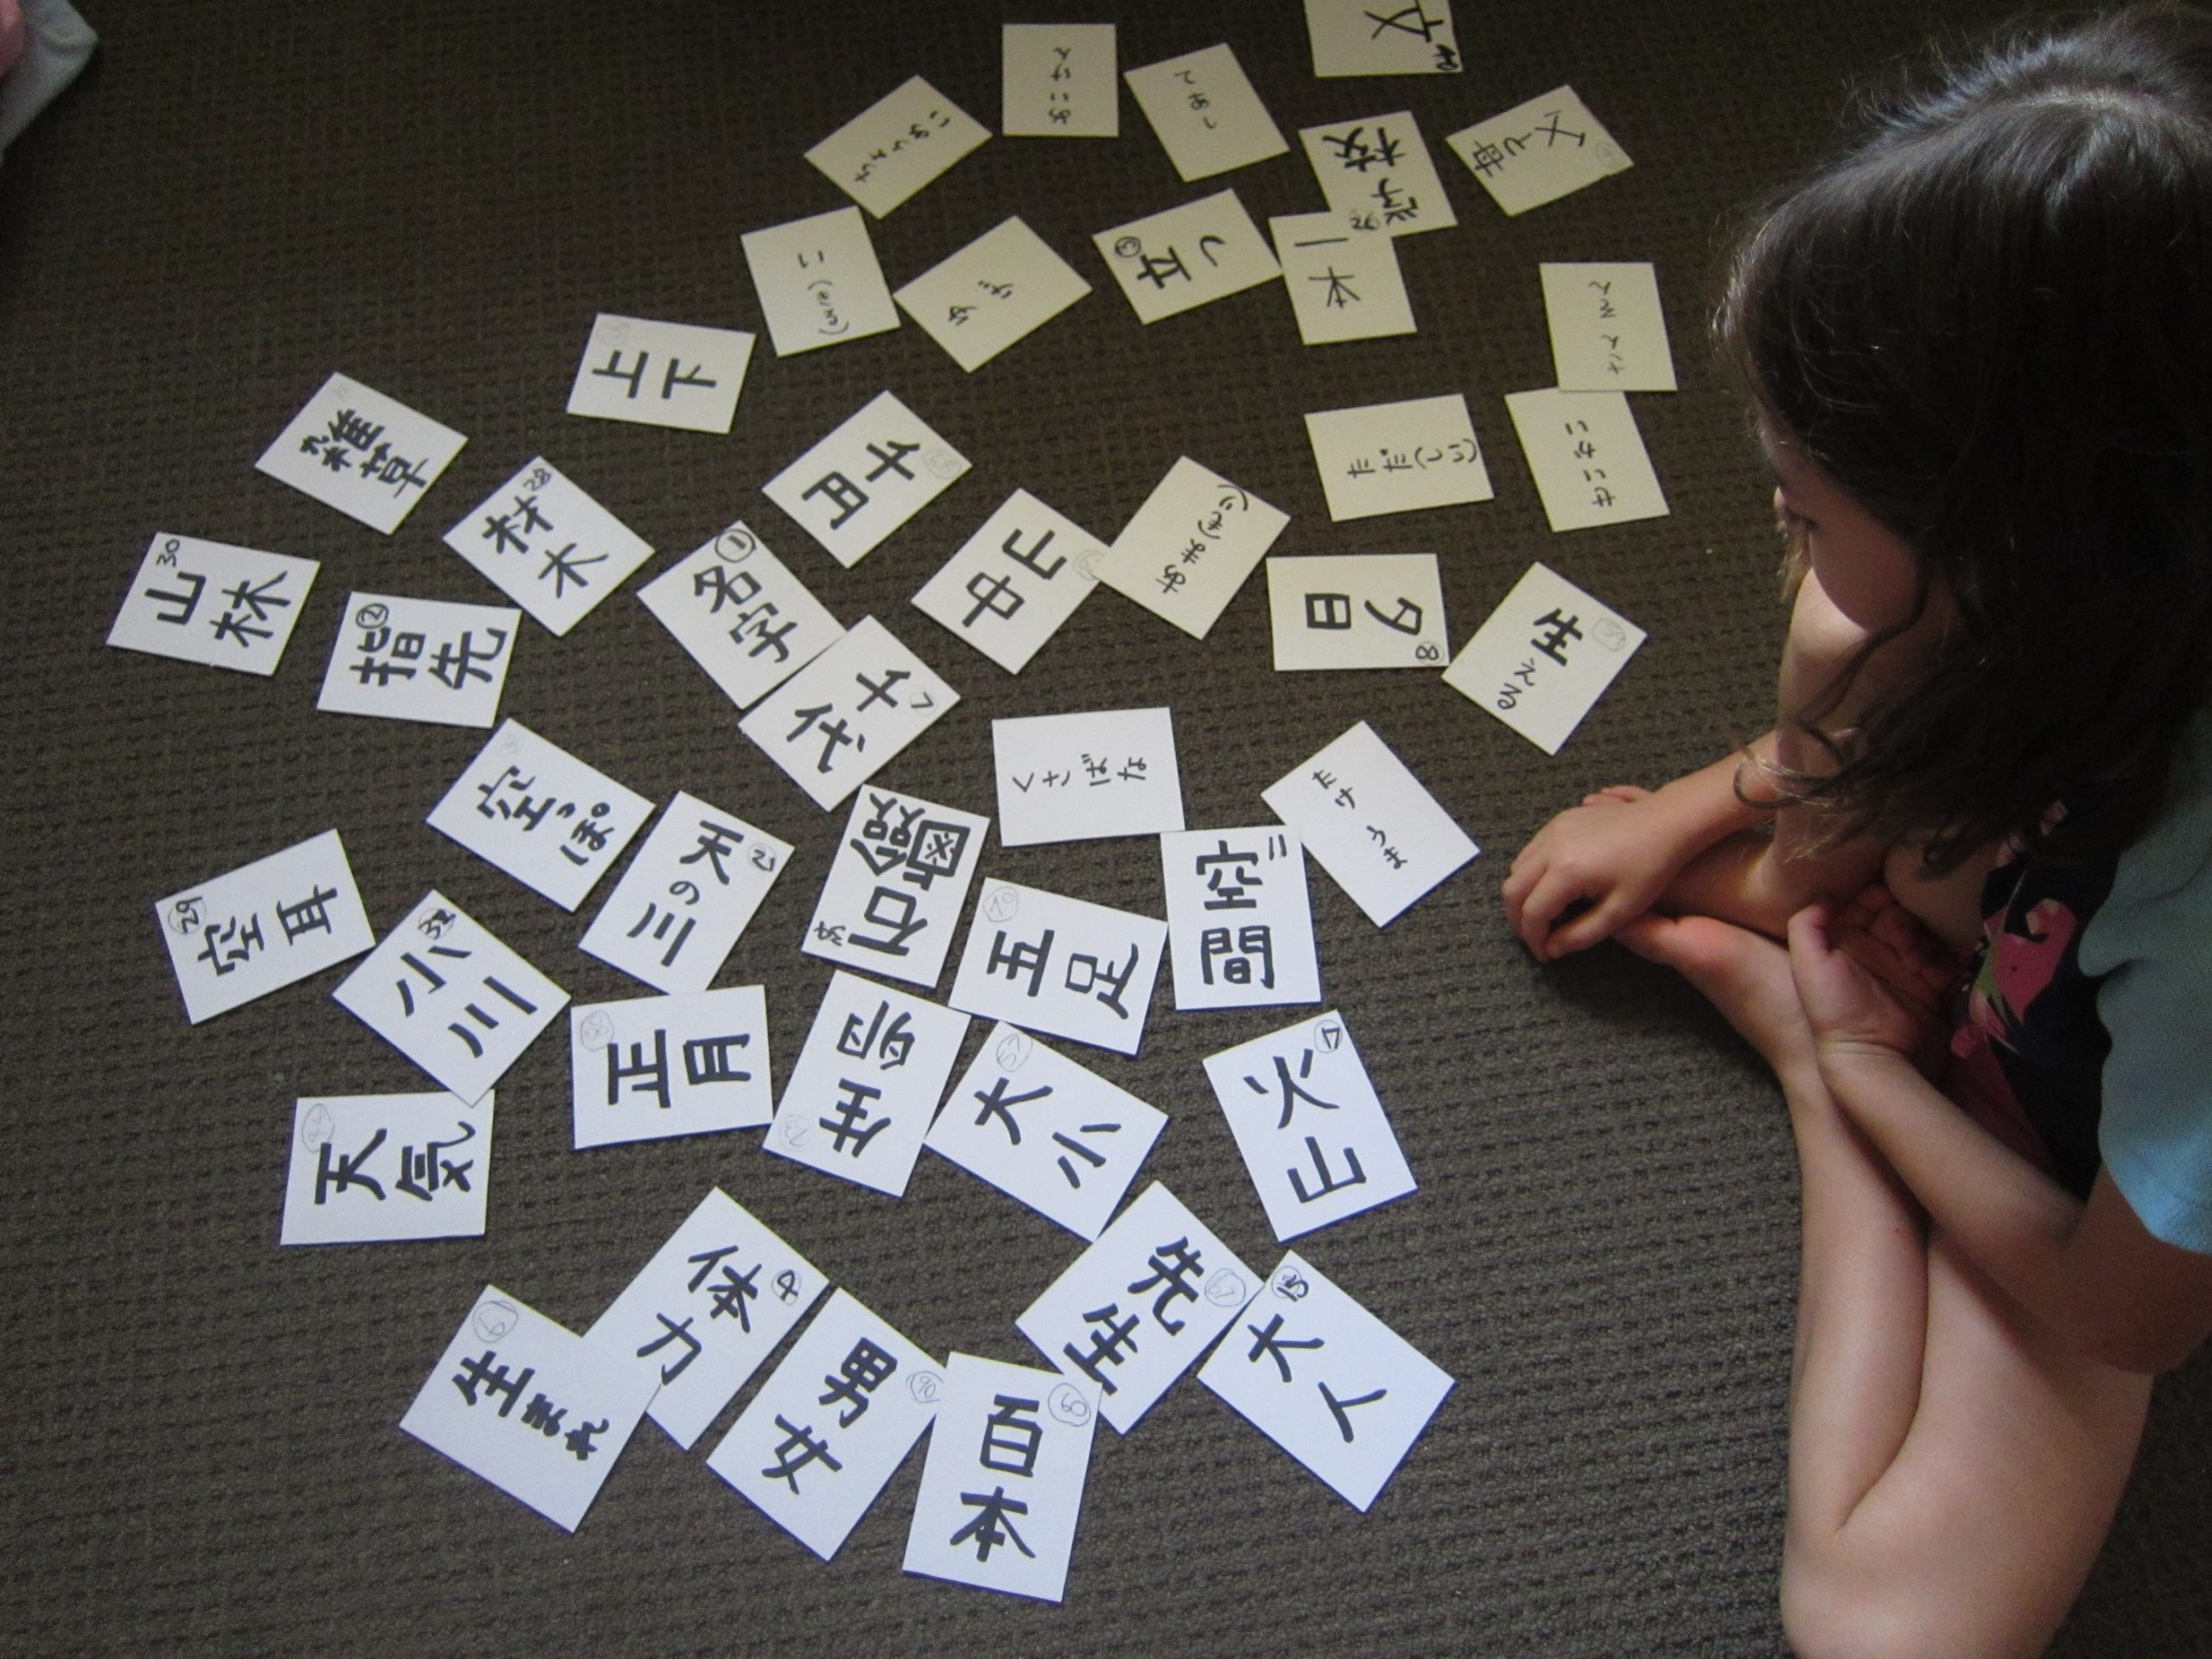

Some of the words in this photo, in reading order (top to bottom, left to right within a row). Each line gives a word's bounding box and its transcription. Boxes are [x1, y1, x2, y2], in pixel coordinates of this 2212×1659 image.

[1322, 127, 1418, 225] 学校
[949, 281, 1012, 325] ゆげ
[1137, 235, 1224, 289] 立つ
[1294, 238, 1360, 308] 一本
[592, 351, 716, 399] 上下
[300, 410, 427, 498] 雑草
[802, 441, 920, 530] 千円
[1566, 421, 1614, 506] せいかい
[156, 539, 180, 567] 30
[482, 496, 608, 598] 材木
[963, 529, 1067, 627] 山中
[144, 571, 290, 647] 山林
[694, 566, 797, 663] 名字
[1305, 593, 1422, 636] 夕日
[349, 626, 508, 690] 指先
[1497, 608, 1583, 709] 生える
[786, 670, 911, 773] 千代
[477, 766, 614, 866] 空っぽ
[1013, 754, 1147, 792] くさばな
[175, 897, 202, 934] 29
[198, 885, 337, 976] 空耳
[627, 820, 744, 967] 天の川
[814, 921, 846, 946] 34
[1196, 839, 1274, 989] 空間
[396, 946, 537, 1058] 小川
[987, 930, 1139, 1020] 五足
[607, 1029, 751, 1109] 正月
[819, 1001, 915, 1158] 生卵
[315, 1122, 475, 1205] 天気
[974, 1077, 1121, 1189] 大小
[1243, 1049, 1366, 1204] 火山
[637, 1246, 761, 1386] 体力
[1064, 1236, 1204, 1395] 先生
[452, 1351, 609, 1460] 生まれ
[762, 1338, 897, 1495] 男女
[1248, 1314, 1387, 1443] 大人
[950, 1395, 1043, 1562] 百本
